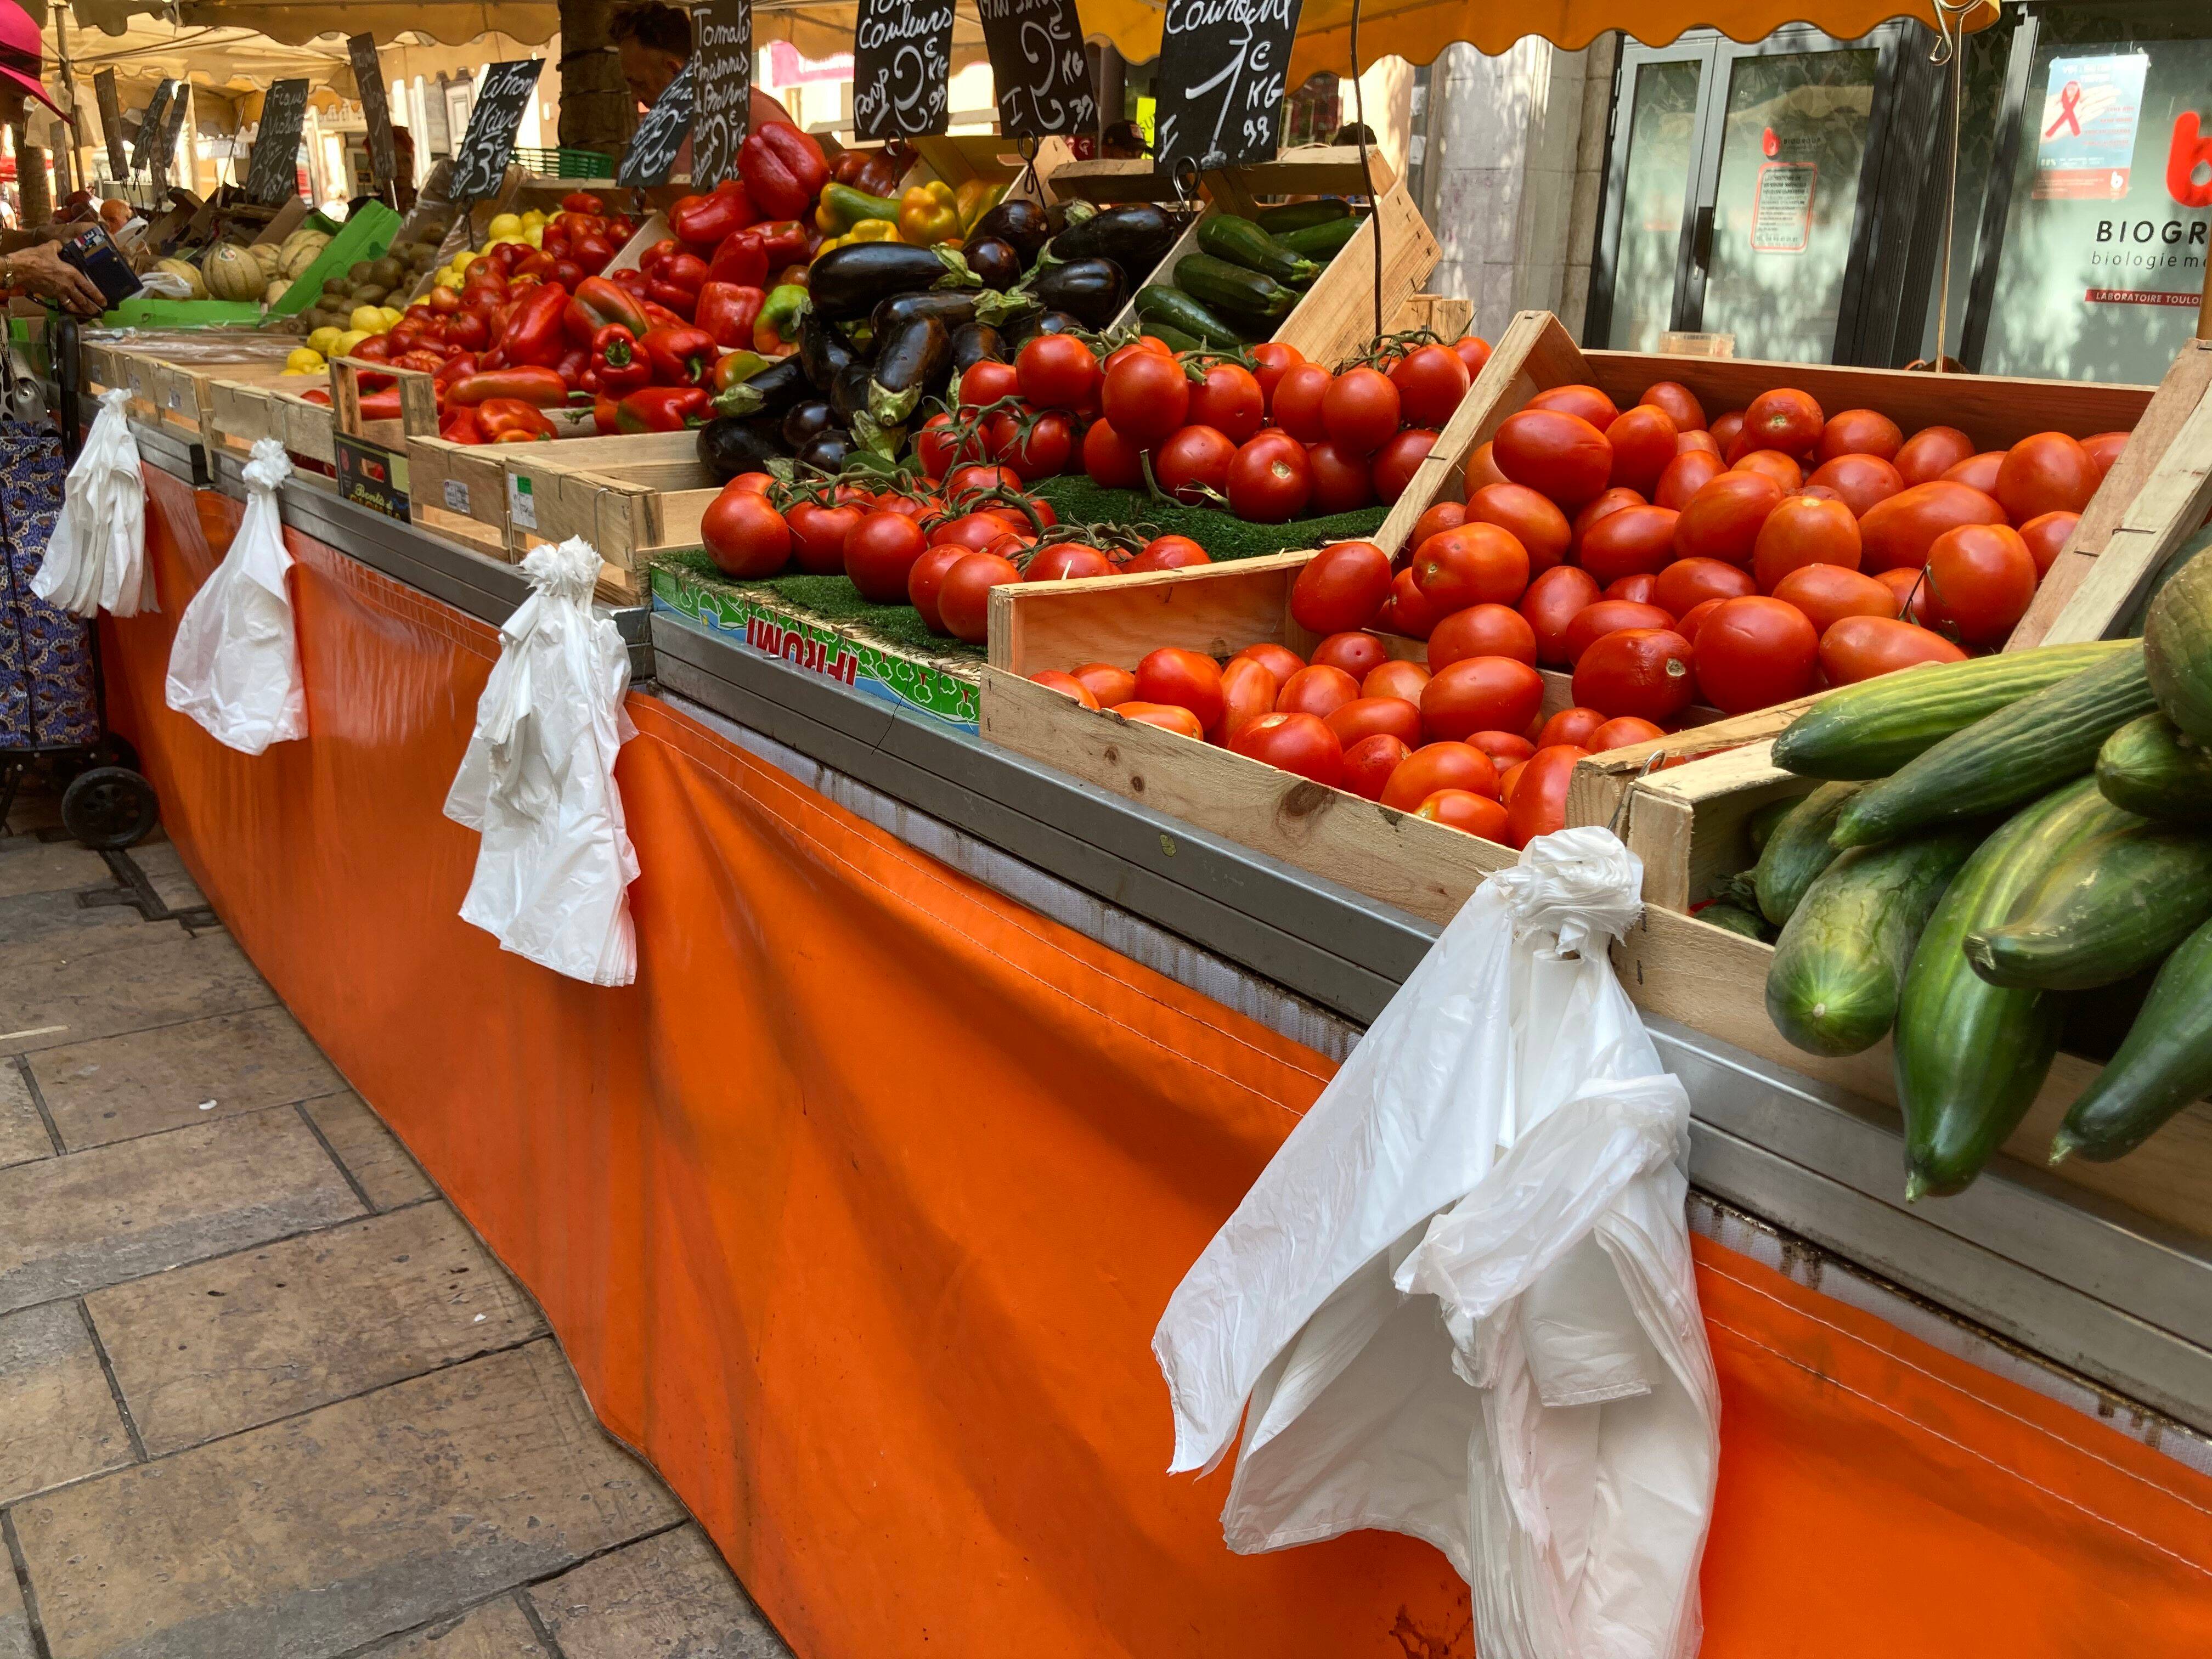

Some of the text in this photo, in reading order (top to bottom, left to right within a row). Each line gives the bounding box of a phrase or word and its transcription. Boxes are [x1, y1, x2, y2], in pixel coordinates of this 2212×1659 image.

[1250, 41, 1271, 71] €
[894, 37, 938, 133] 2 €
[1246, 72, 1283, 111] KG
[2096, 221, 2208, 244] BIOGR
[2092, 250, 2207, 270] biologie m
[2096, 292, 2202, 304] LABORATOIRE TOULO
